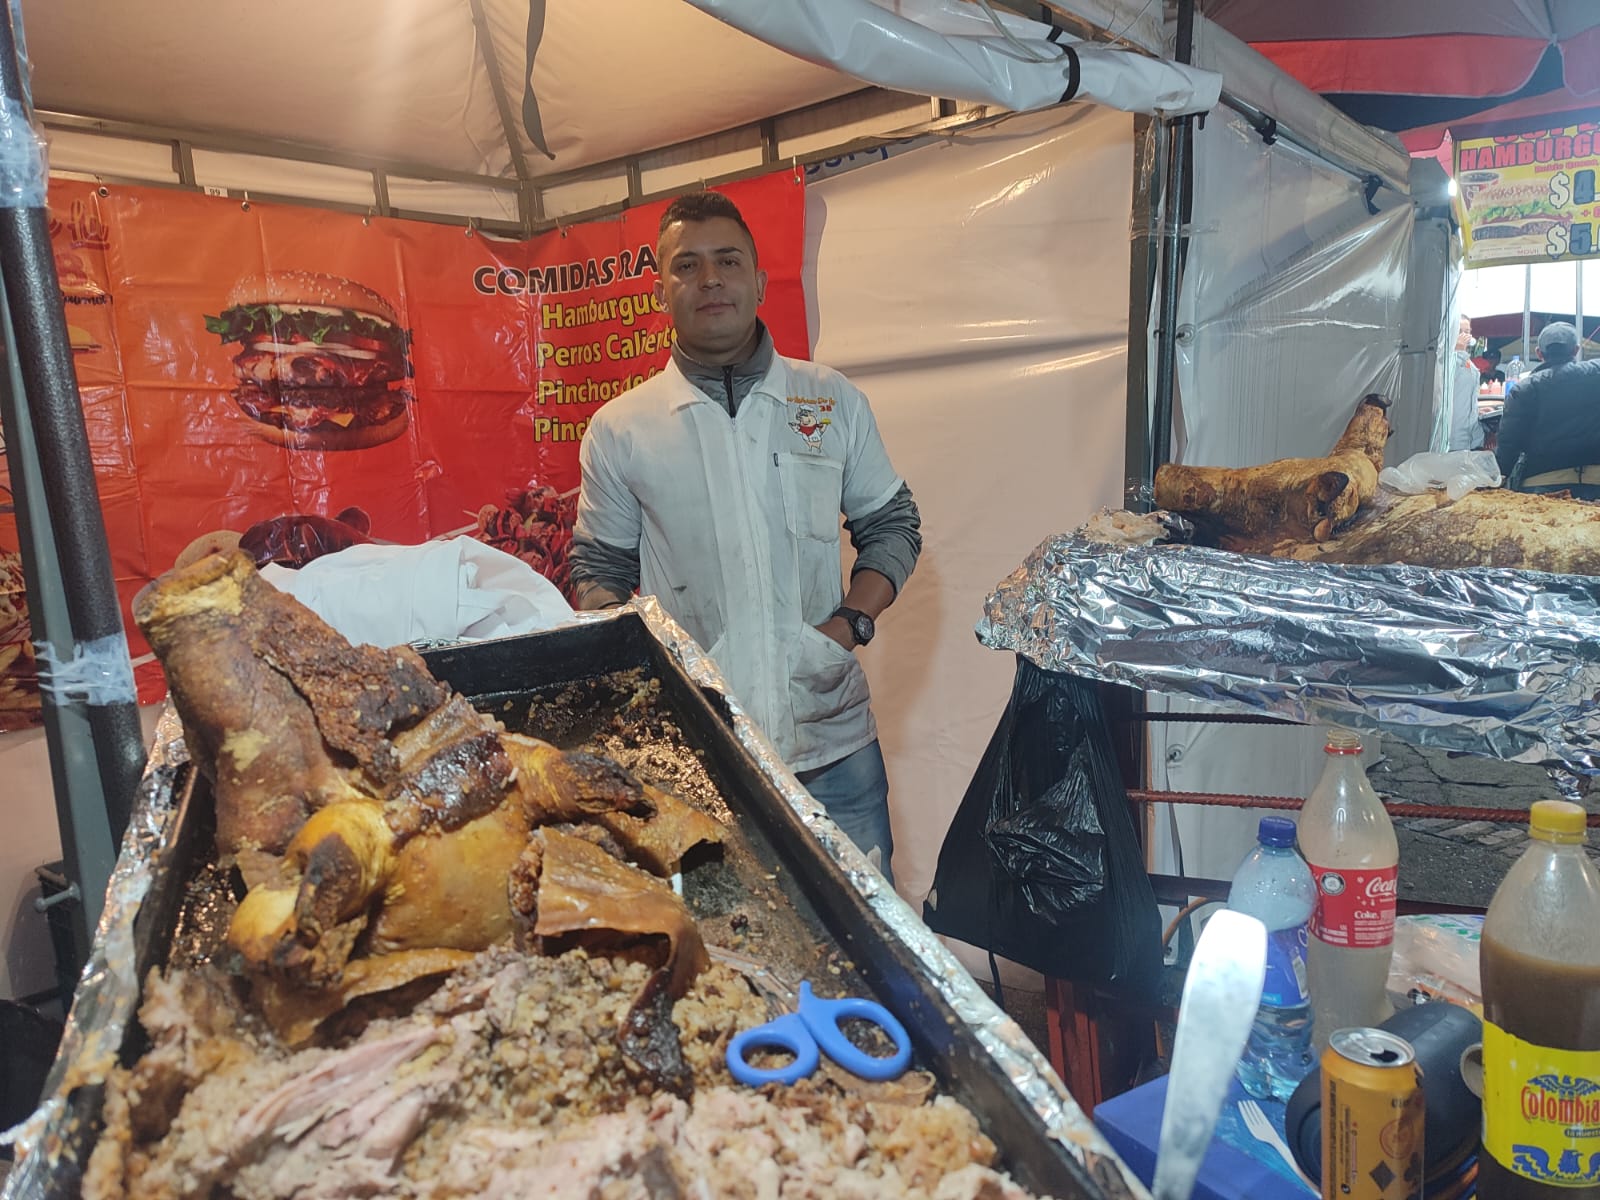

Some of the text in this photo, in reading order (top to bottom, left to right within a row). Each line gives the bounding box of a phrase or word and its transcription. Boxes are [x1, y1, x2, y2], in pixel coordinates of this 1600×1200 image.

[473, 256, 616, 296] COMIDAS
[537, 342, 602, 368] Perros
[537, 377, 619, 405] Pinchos
